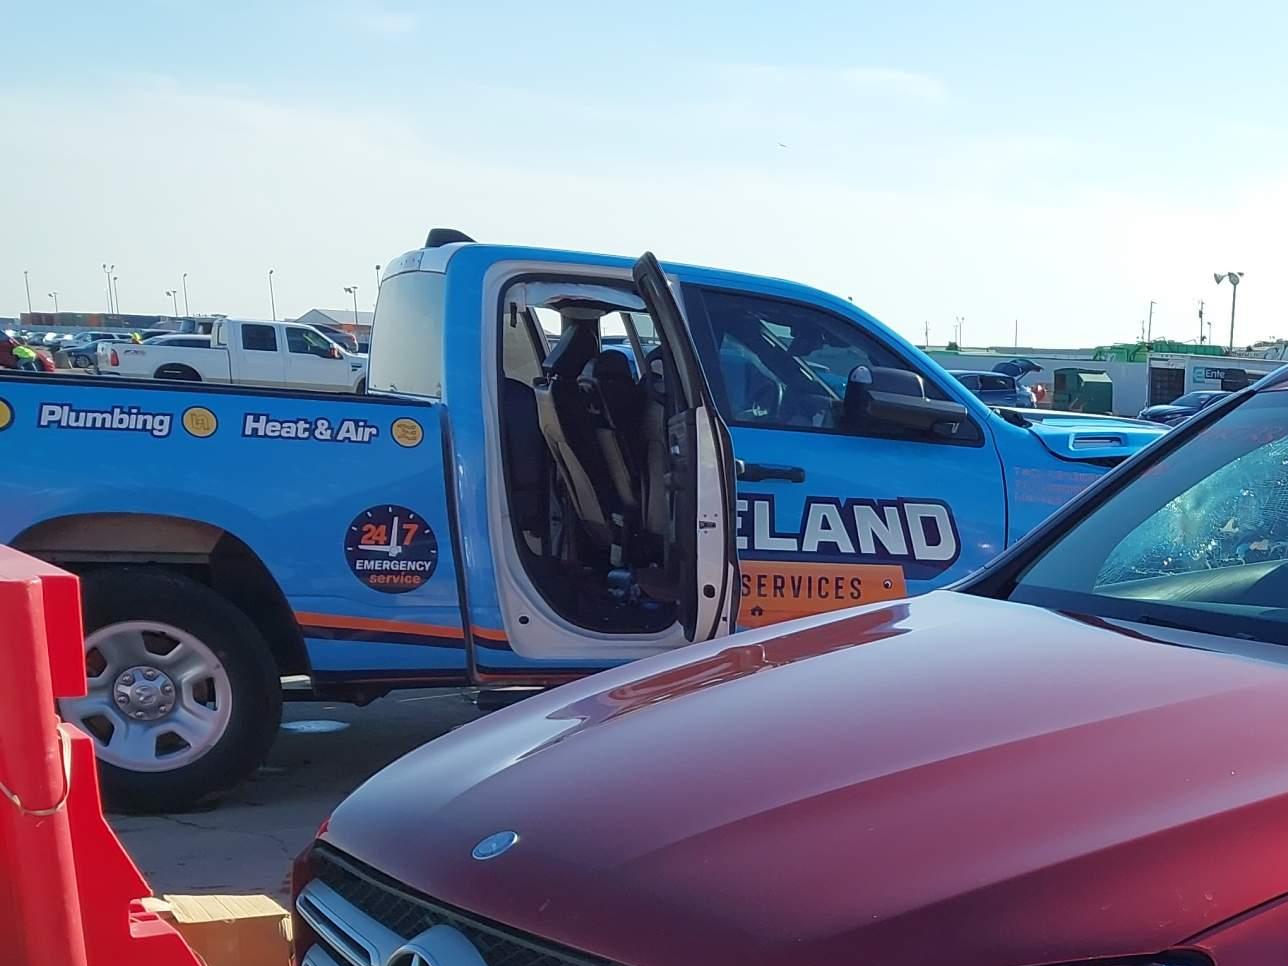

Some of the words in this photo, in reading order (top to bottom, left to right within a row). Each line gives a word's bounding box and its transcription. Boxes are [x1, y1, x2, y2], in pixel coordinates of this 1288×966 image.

[40, 404, 170, 436] Plumbing
[244, 414, 310, 439] Heat
[314, 419, 332, 441] &
[336, 420, 377, 442] Air
[361, 523, 388, 545] 24
[402, 523, 419, 546] 7
[737, 500, 956, 561] LAND
[355, 559, 432, 572] EMERGENCY
[369, 571, 422, 585] service
[741, 574, 862, 600] SERVICES
